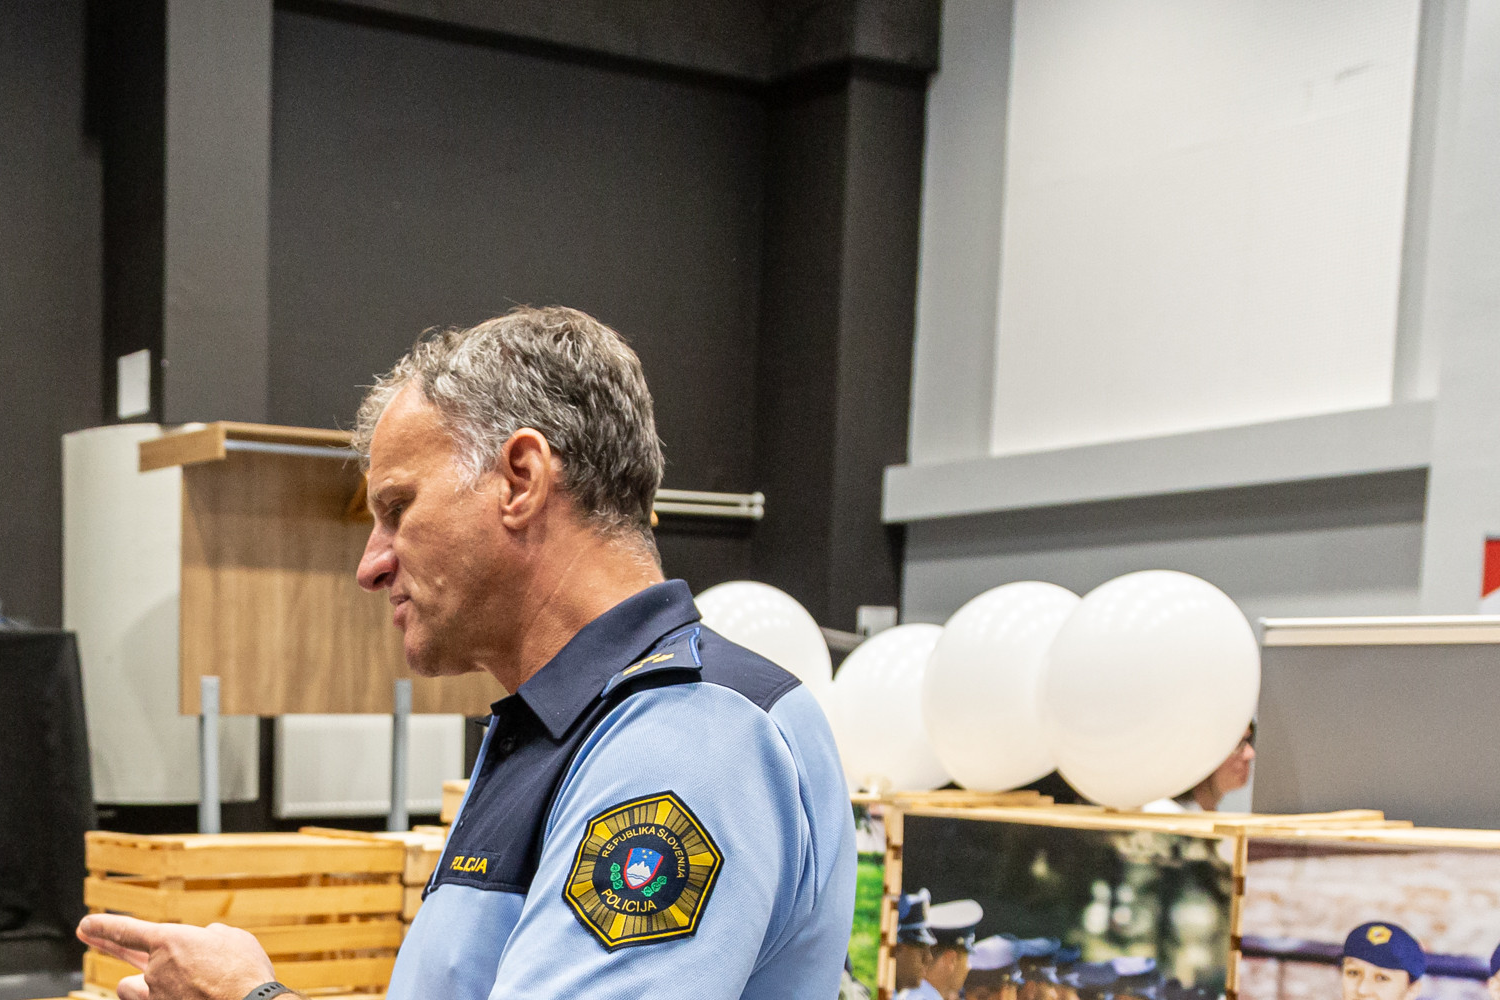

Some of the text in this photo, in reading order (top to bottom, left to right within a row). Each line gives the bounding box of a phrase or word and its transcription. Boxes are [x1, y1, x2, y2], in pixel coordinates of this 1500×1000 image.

[601, 826, 686, 879] REPUBLIKA SLOVENIJA
[601, 888, 658, 912] POLICIJA
